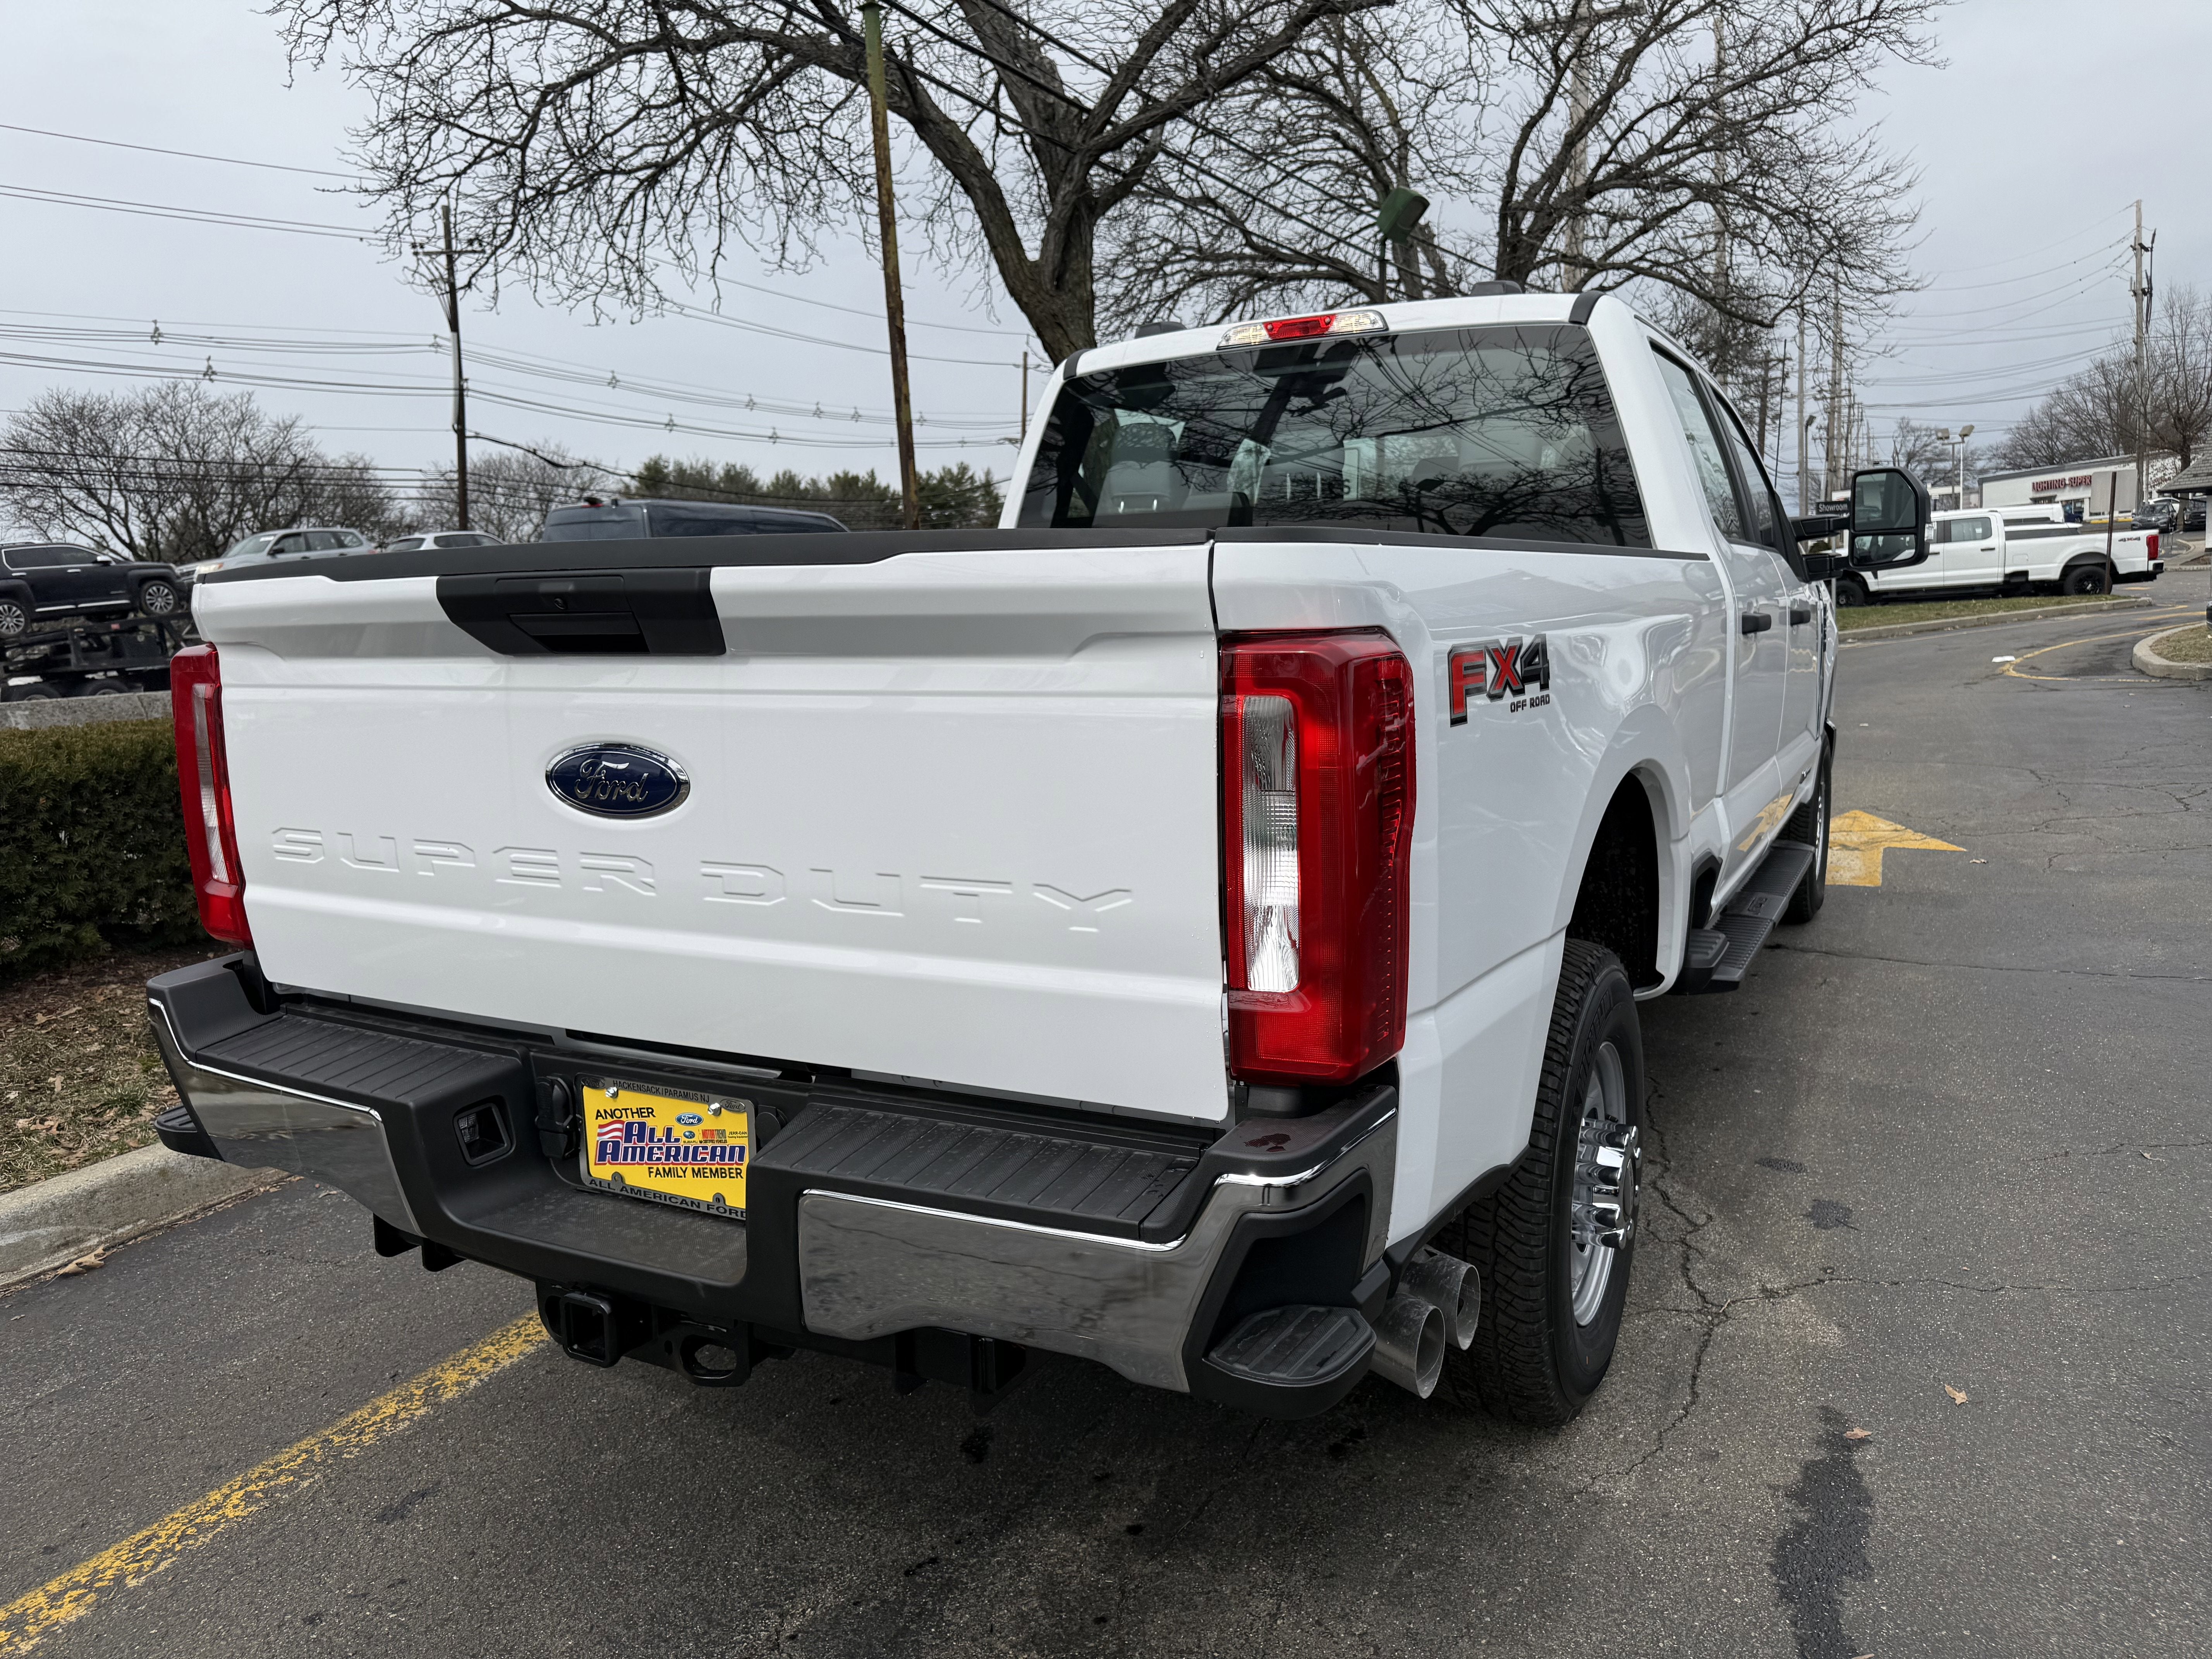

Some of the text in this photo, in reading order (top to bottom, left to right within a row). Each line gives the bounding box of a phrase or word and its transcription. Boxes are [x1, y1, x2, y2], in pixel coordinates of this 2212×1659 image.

[2032, 478, 2066, 491] LIGHTING
[1819, 503, 1848, 512] Showroom
[1448, 634, 1550, 727] FX4
[1510, 694, 1550, 713] OFF ROAD
[574, 758, 649, 802] Ford
[272, 827, 1132, 932] SUPER DUTY
[700, 1094, 709, 1103] NJ
[725, 1100, 740, 1110] Ford
[595, 1107, 656, 1120] ANOTHER
[680, 1115, 698, 1123] Ford
[648, 1167, 744, 1179] FAMILY MEMBER
[589, 1179, 615, 1191] ALL
[620, 1186, 701, 1209] AMERICAN
